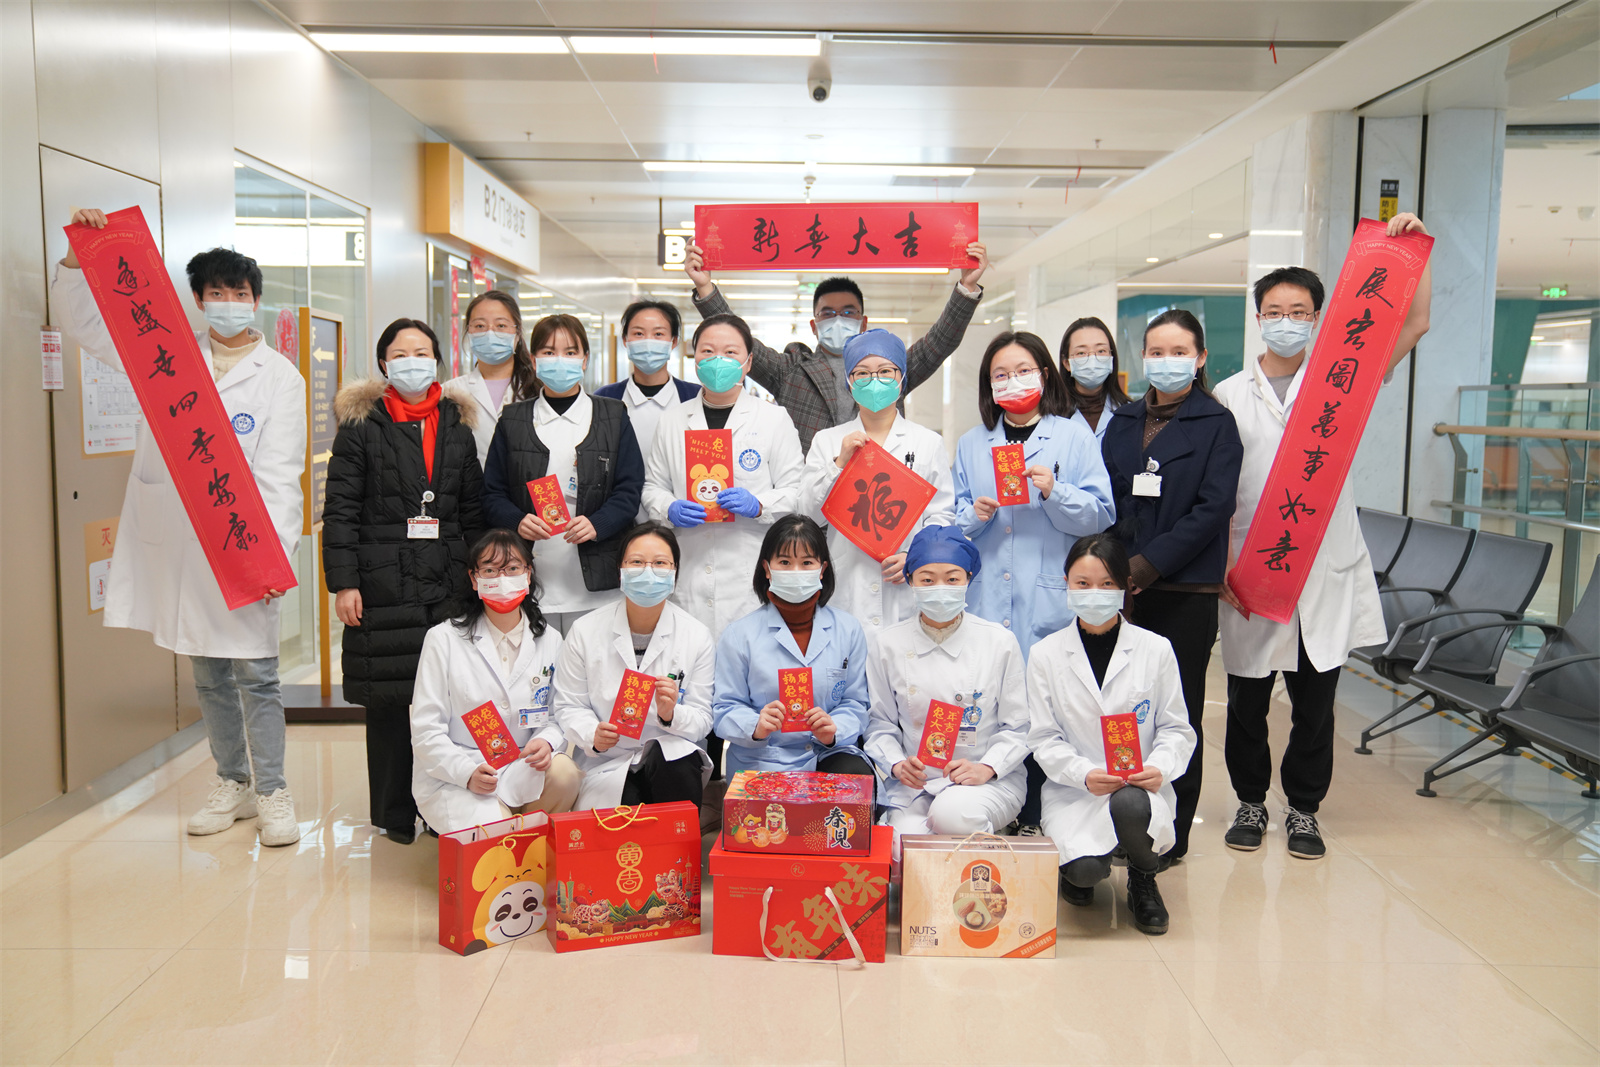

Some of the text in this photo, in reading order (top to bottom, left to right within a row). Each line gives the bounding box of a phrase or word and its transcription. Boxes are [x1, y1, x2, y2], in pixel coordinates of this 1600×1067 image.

[89, 237, 105, 249] HAPPY
[105, 232, 118, 240] NEW
[751, 210, 922, 262] 新春大吉
[1386, 243, 1399, 252] NEW
[1399, 249, 1412, 260] YEAR
[690, 446, 726, 460] MEET YOU
[847, 472, 907, 541] 福
[792, 863, 804, 875] 礼
[909, 925, 937, 935] NUTS
[605, 935, 624, 943] HAPPY
[625, 933, 638, 941] NEW
